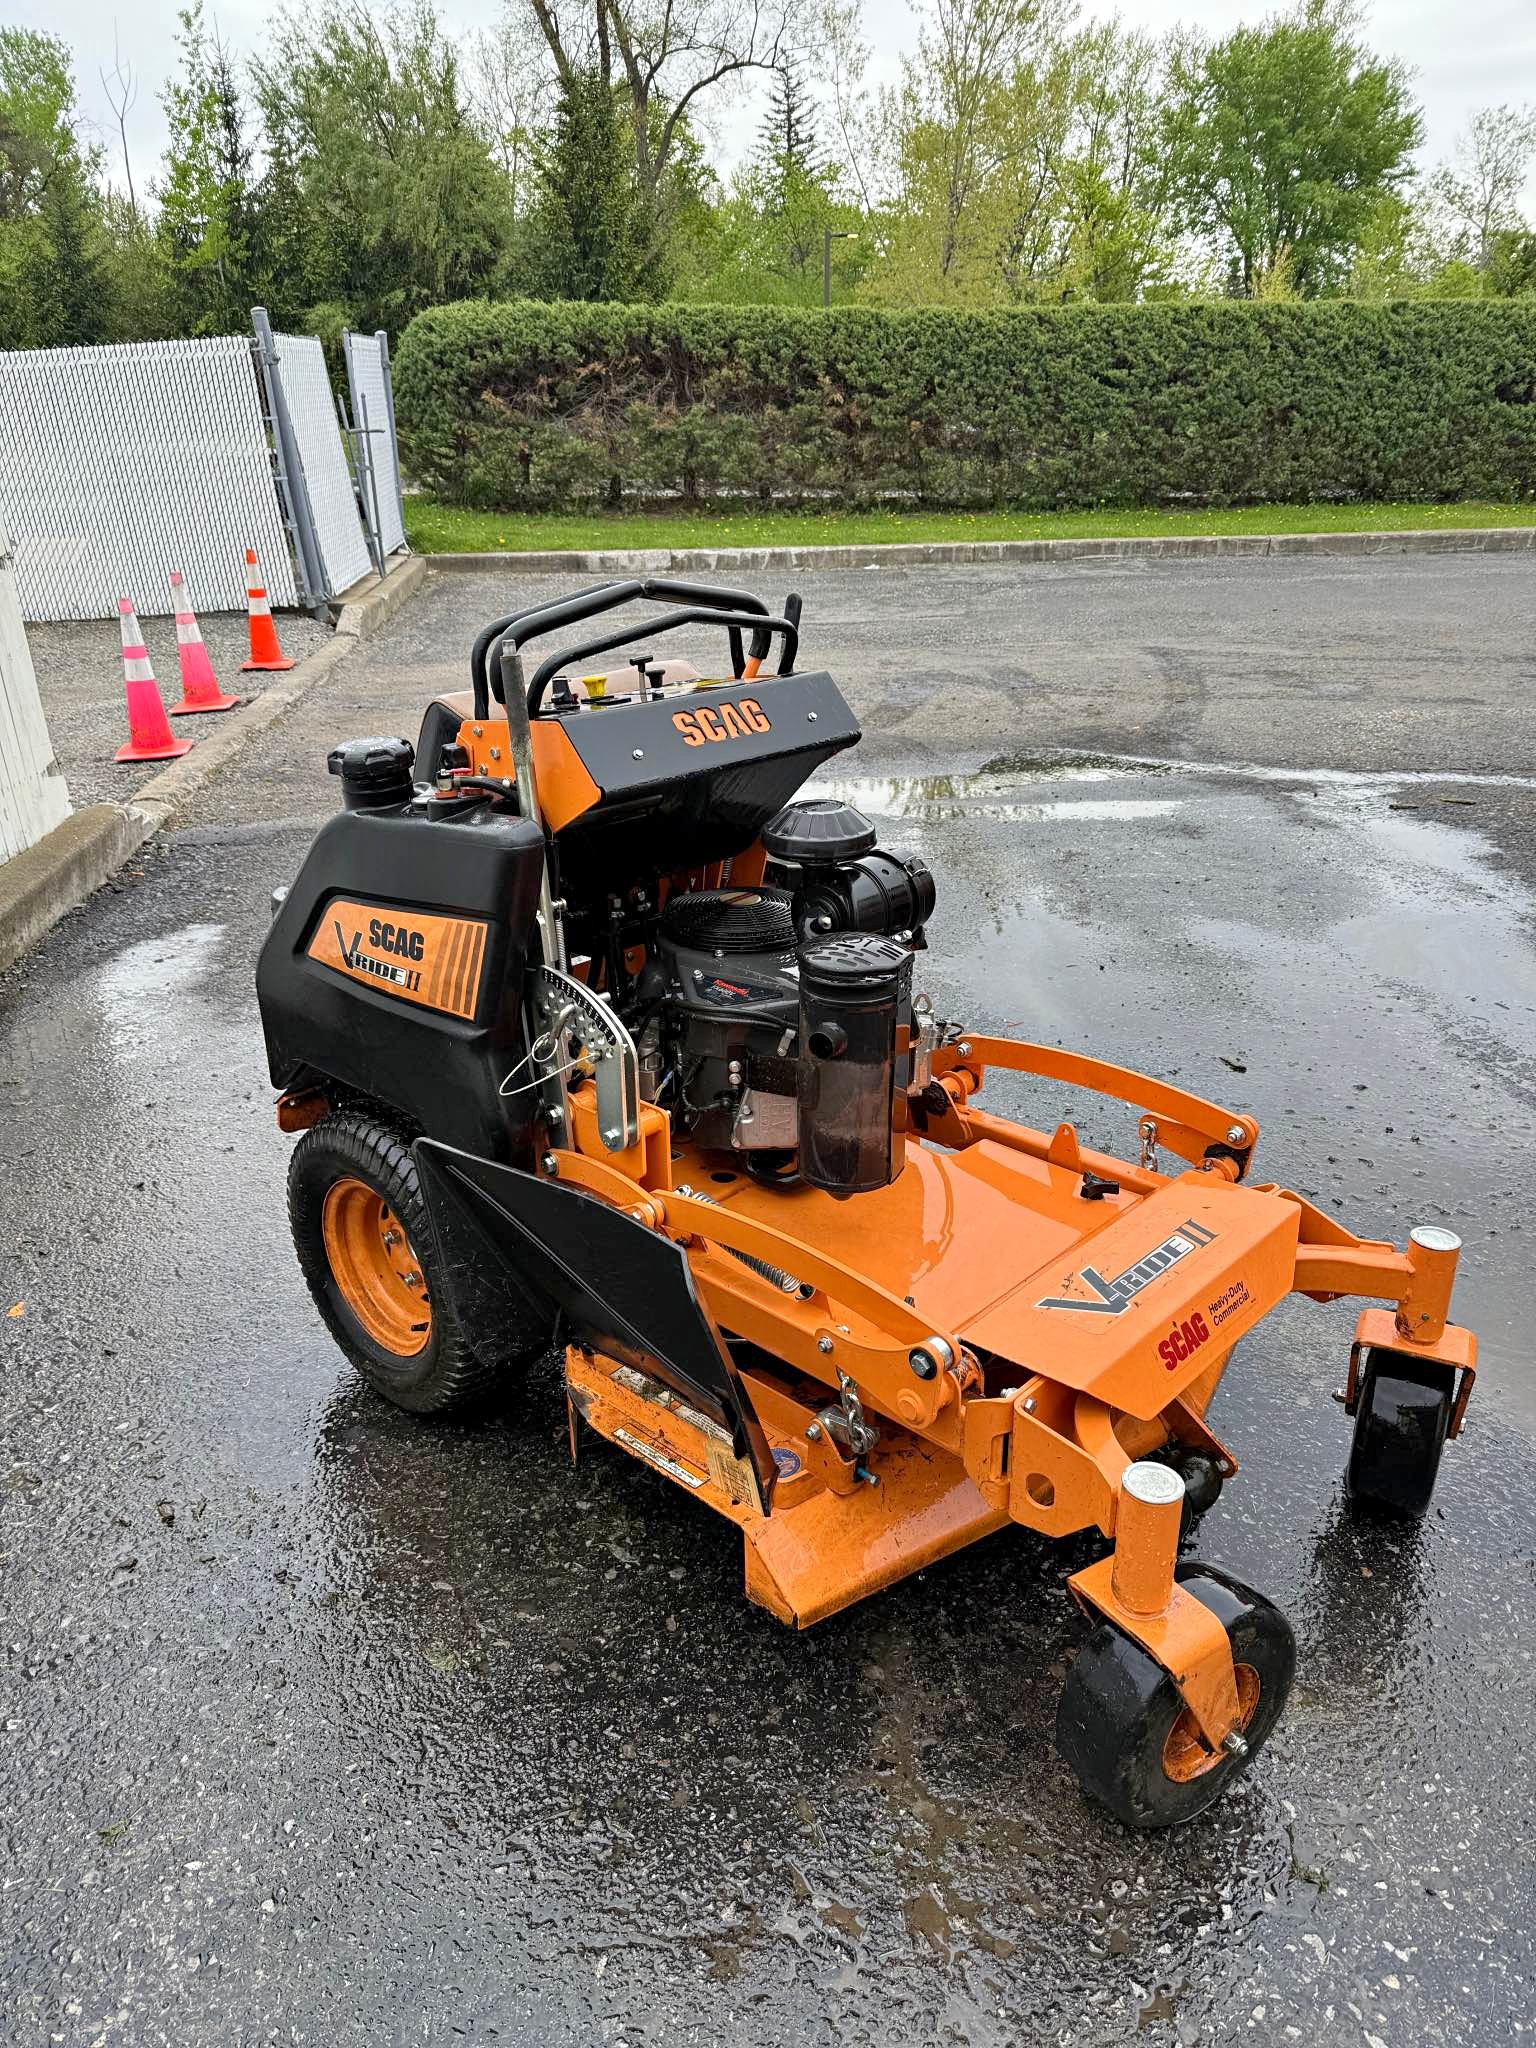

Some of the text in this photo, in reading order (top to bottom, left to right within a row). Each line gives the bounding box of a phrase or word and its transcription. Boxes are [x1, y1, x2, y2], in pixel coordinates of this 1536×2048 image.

[672, 698, 772, 747] SCAG
[369, 918, 425, 962] SCAG
[1208, 1280, 1244, 1316] Heavy-Duty
[1213, 1288, 1250, 1326] Commercial
[1158, 1311, 1210, 1371] SCAG
